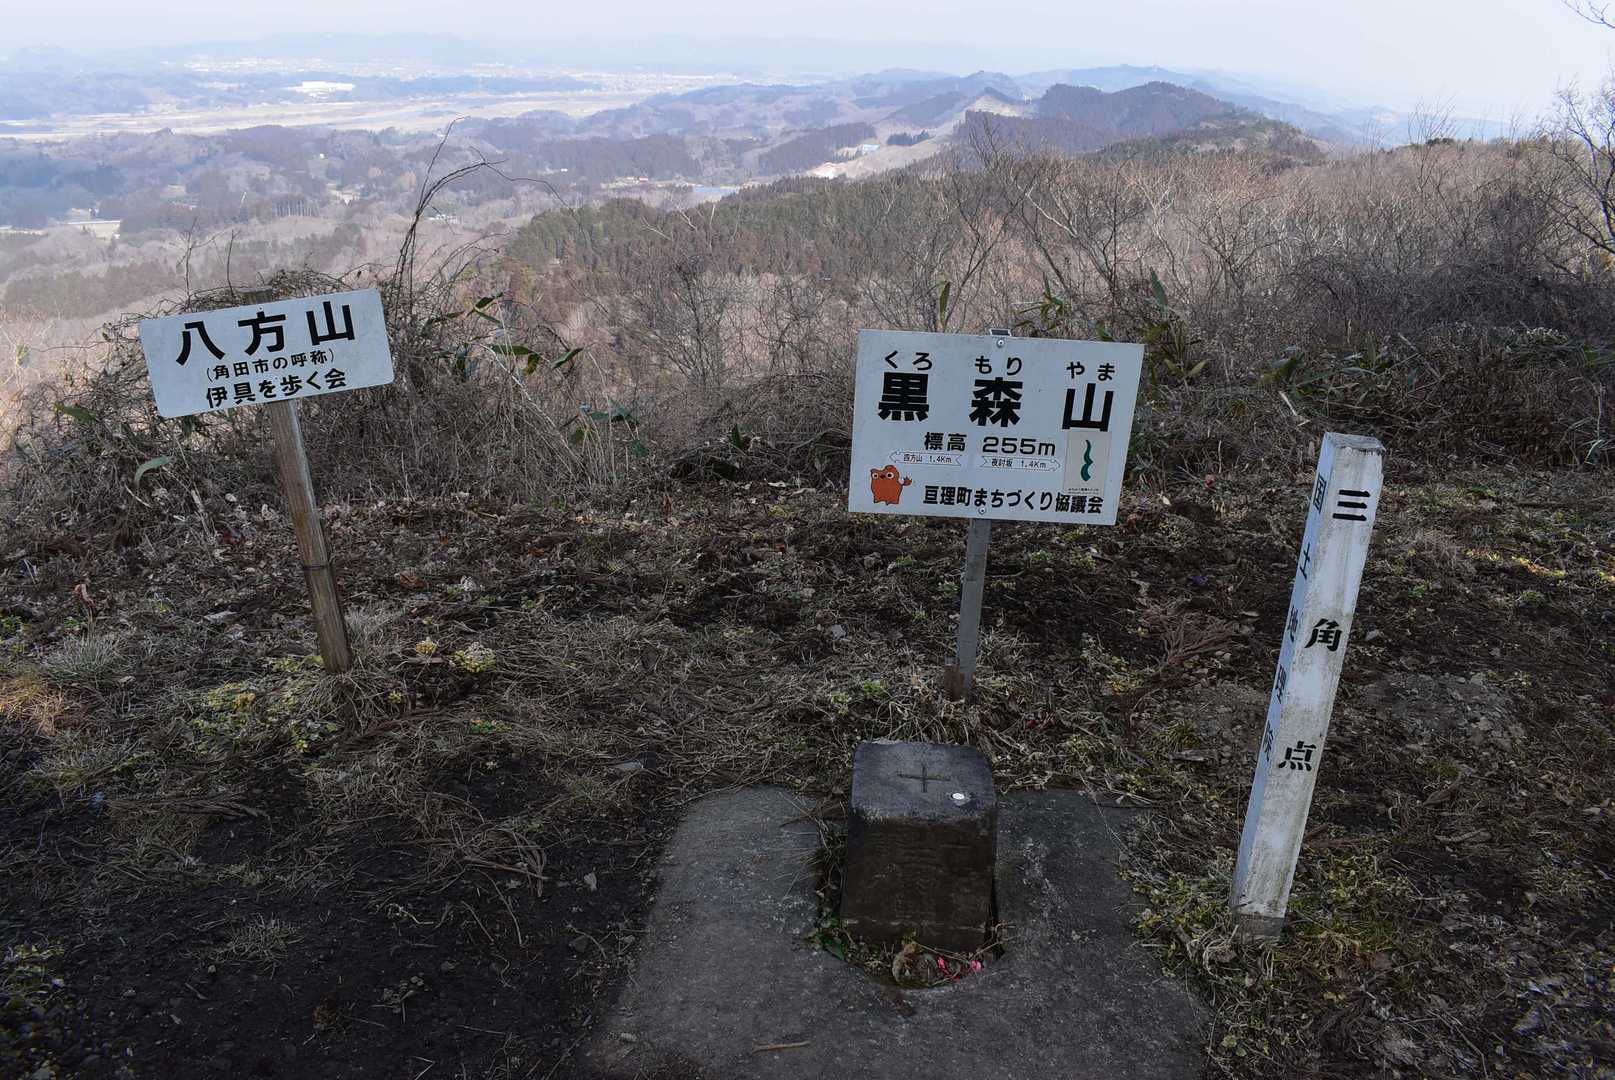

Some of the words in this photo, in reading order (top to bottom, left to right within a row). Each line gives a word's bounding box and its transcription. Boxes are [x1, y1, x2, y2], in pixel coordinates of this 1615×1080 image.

[176, 301, 355, 366] 八方山
[206, 348, 335, 383] (角田市の呼称)
[884, 350, 933, 372] くろ
[974, 355, 1023, 376] もり
[1066, 361, 1116, 382] やま
[206, 367, 347, 409] 伊具を歩く会
[878, 371, 1115, 432] 黒森山
[923, 431, 968, 452] 標高
[981, 436, 1057, 457] 255m
[922, 484, 1105, 515] 亘理町まちづくり協議会
[1278, 489, 1372, 773] 三角点
